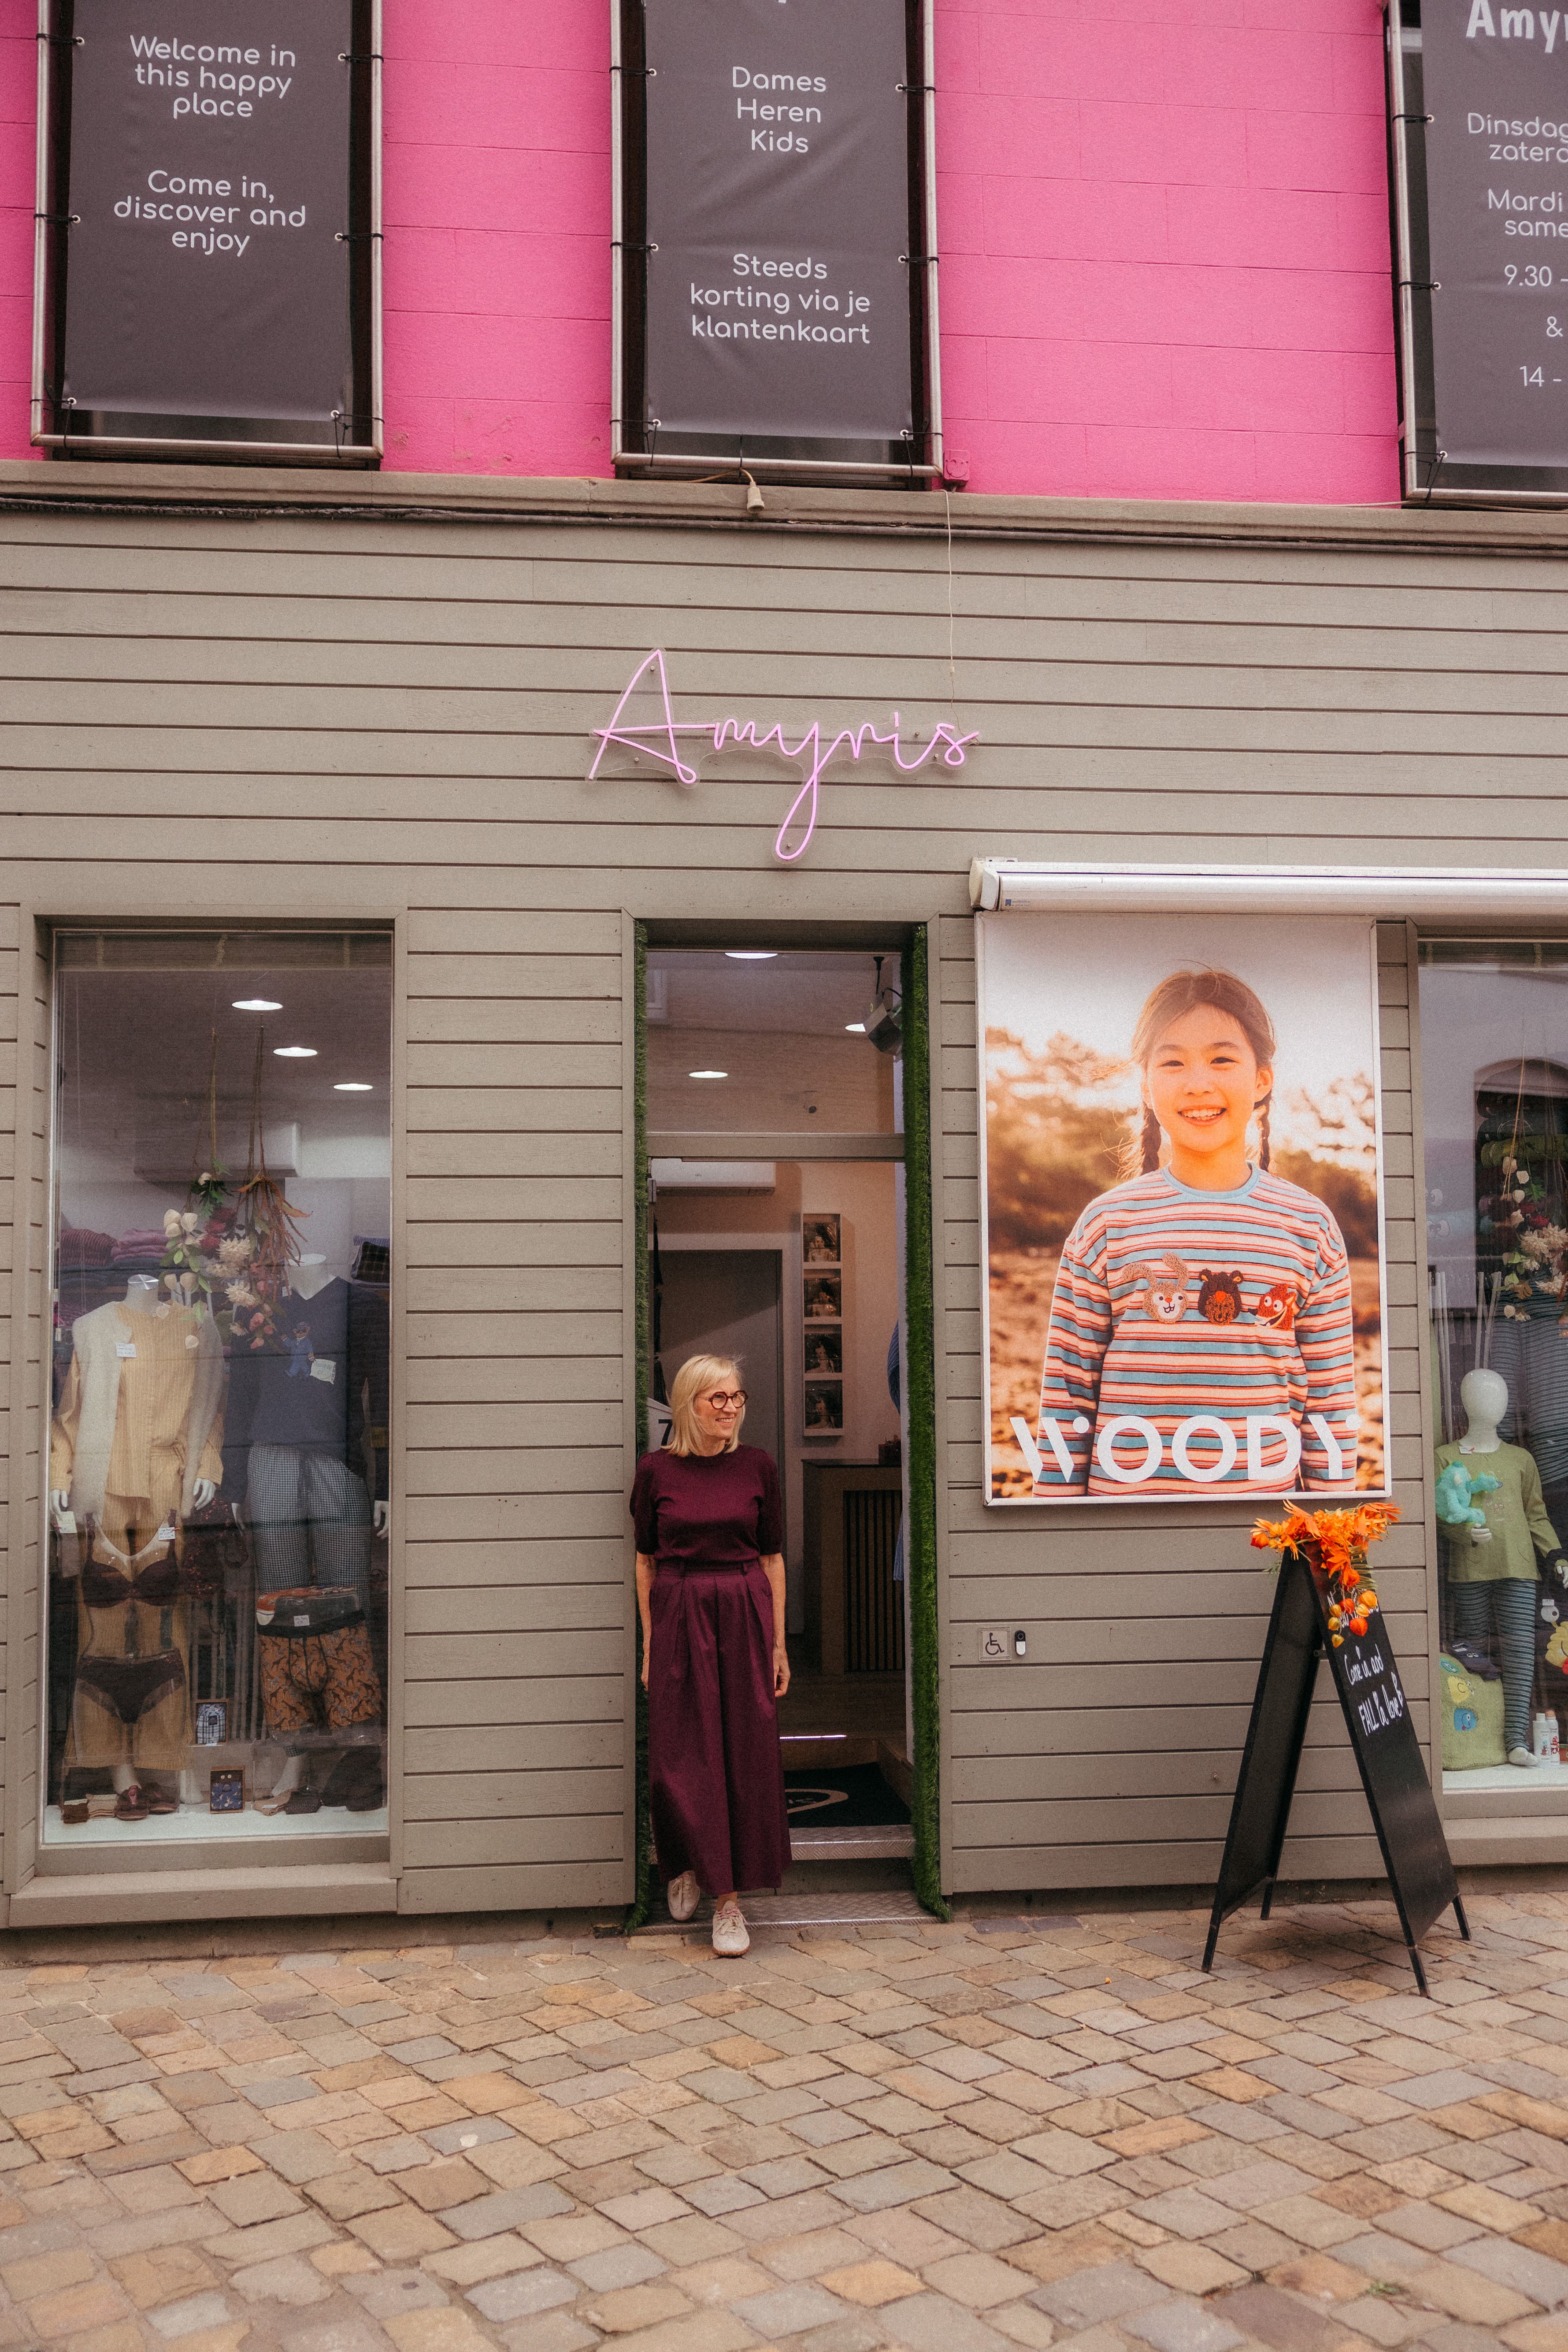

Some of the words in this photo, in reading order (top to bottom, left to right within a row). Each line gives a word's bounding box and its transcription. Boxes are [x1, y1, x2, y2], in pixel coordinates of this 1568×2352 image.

[1466, 0, 1568, 53] Amy
[130, 35, 260, 65] Welcome
[271, 44, 296, 67] in
[134, 62, 189, 87] this
[200, 66, 292, 99] happy
[732, 66, 827, 93] Dames
[173, 92, 253, 119] place
[737, 97, 822, 124] Heren
[751, 129, 809, 153] Kids
[1467, 112, 1568, 144] Dinsdag
[148, 170, 231, 197] Come
[242, 175, 274, 204] in,
[1487, 188, 1563, 213] Mardi
[114, 195, 241, 224] discover
[249, 205, 306, 227] and
[171, 227, 250, 257] enjoy
[1504, 219, 1568, 238] same
[733, 252, 828, 280] Steeds
[1504, 263, 1553, 288] 9.30
[690, 282, 790, 315] korting
[798, 288, 839, 312] via
[844, 290, 871, 318] je
[692, 314, 871, 345] klantenkaart
[1546, 315, 1564, 338] &
[1519, 365, 1545, 387] 14
[589, 649, 979, 860] Amyris
[1009, 1414, 1362, 1483] WOODY
[1344, 1654, 1363, 1685] Come
[1371, 1643, 1384, 1674] and
[1358, 1697, 1379, 1737] FALL
